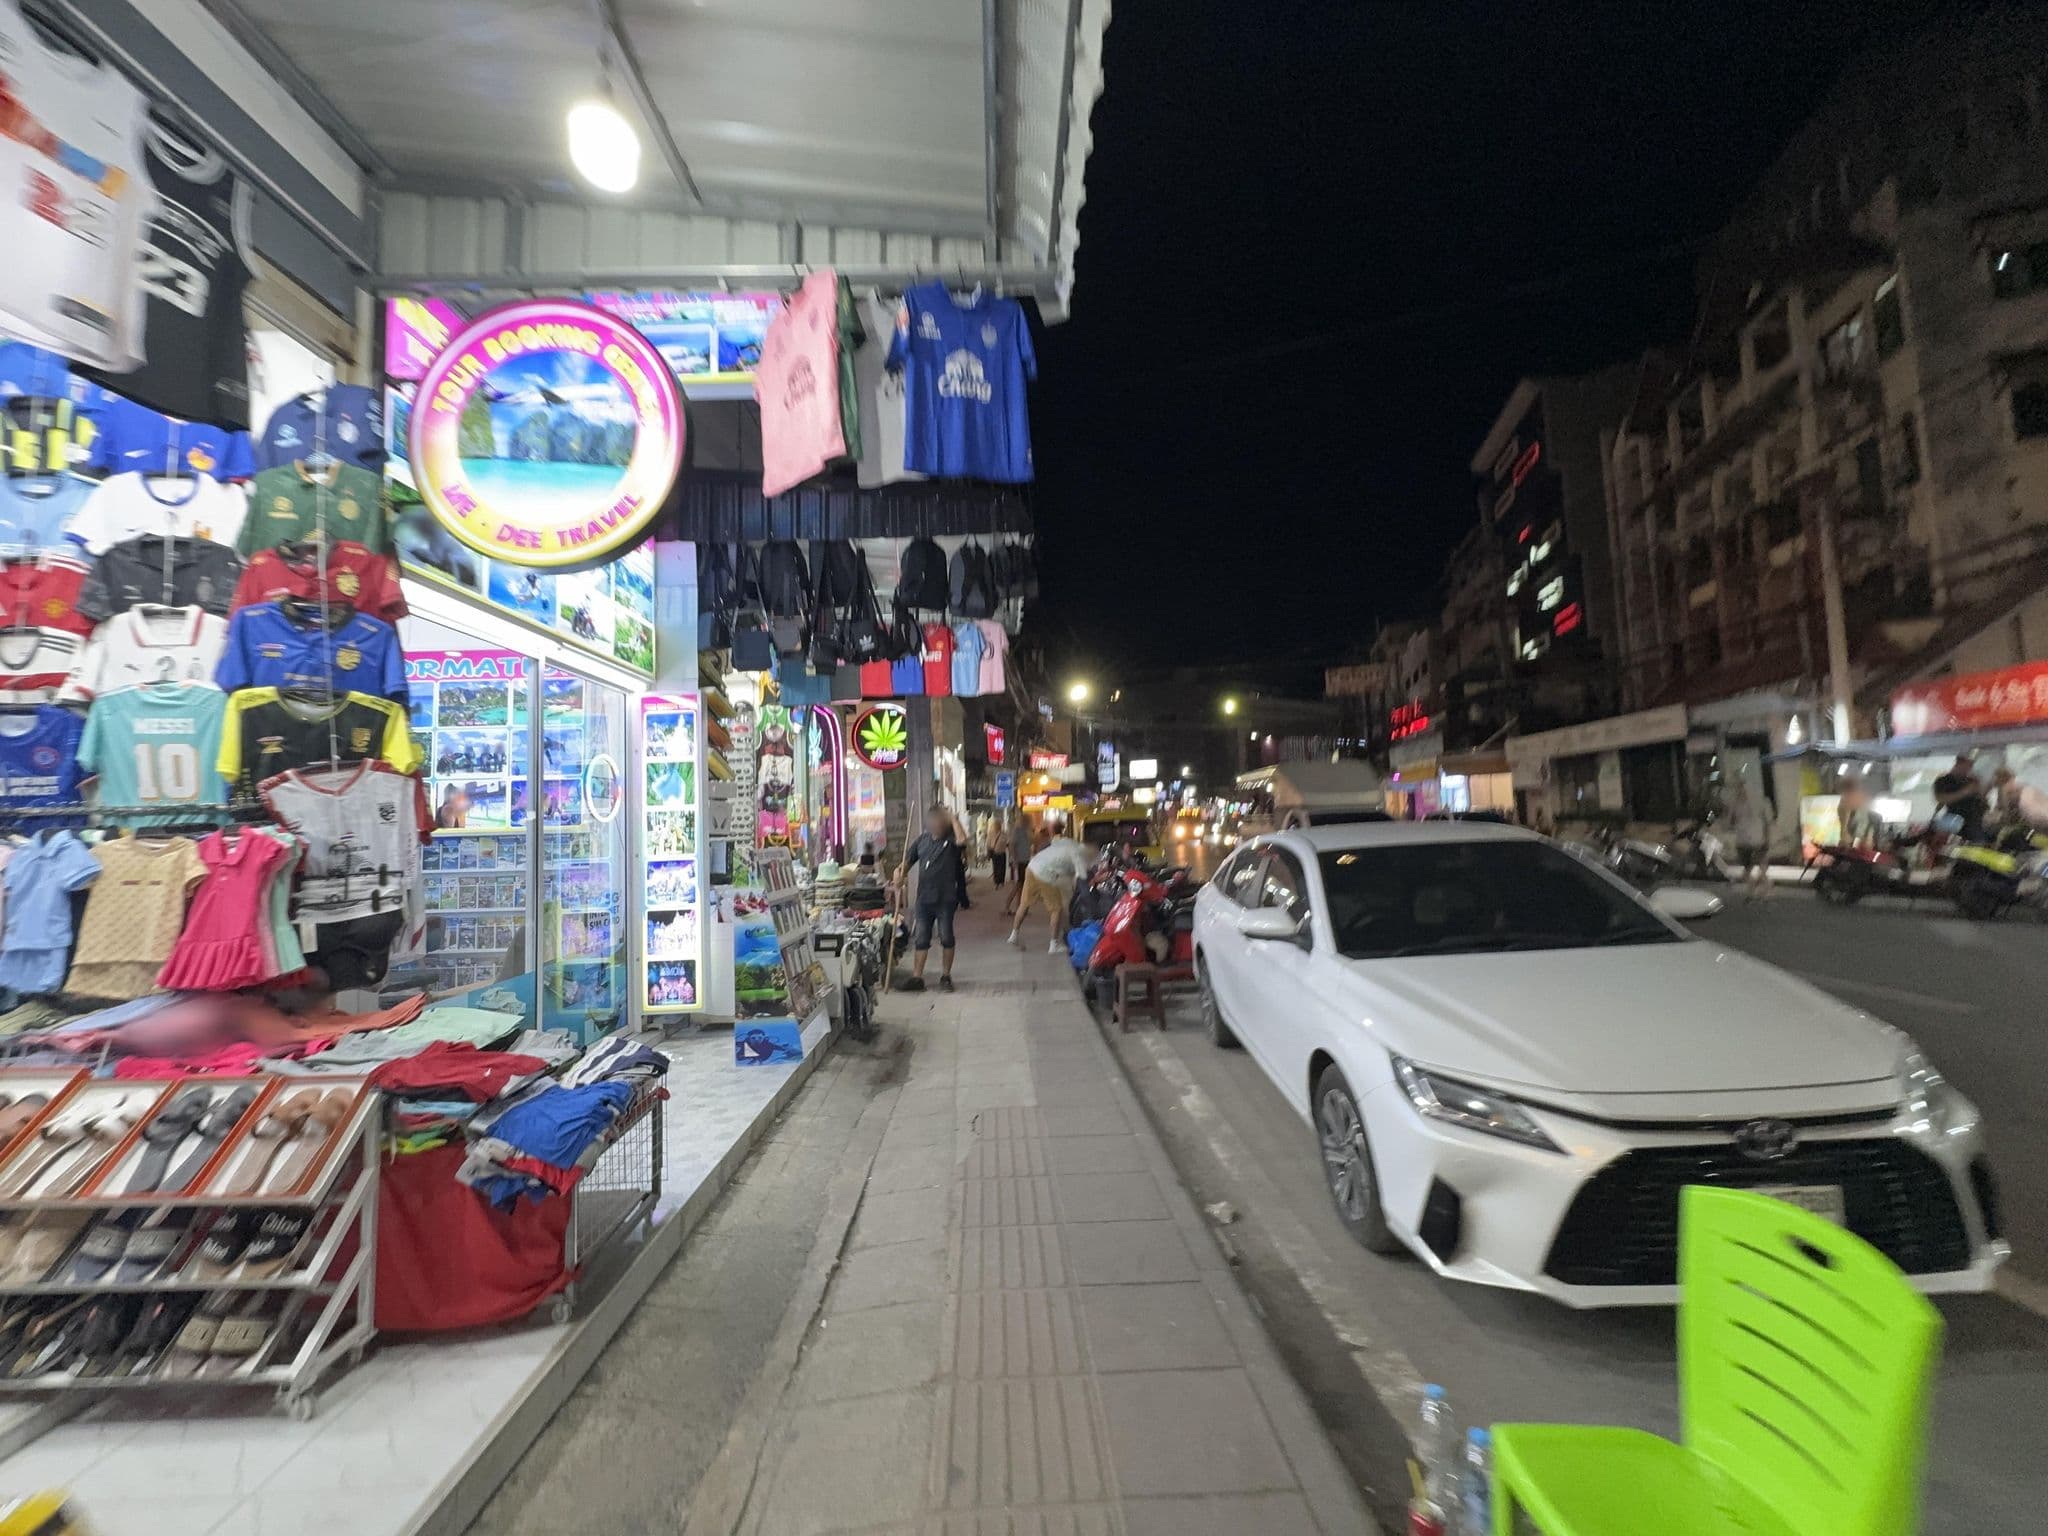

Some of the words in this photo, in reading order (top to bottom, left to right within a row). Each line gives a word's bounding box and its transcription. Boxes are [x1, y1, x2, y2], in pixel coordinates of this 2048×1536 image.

[495, 523, 543, 549] DEE
[556, 494, 645, 548] TRAVEL
[135, 743, 200, 801] 10
